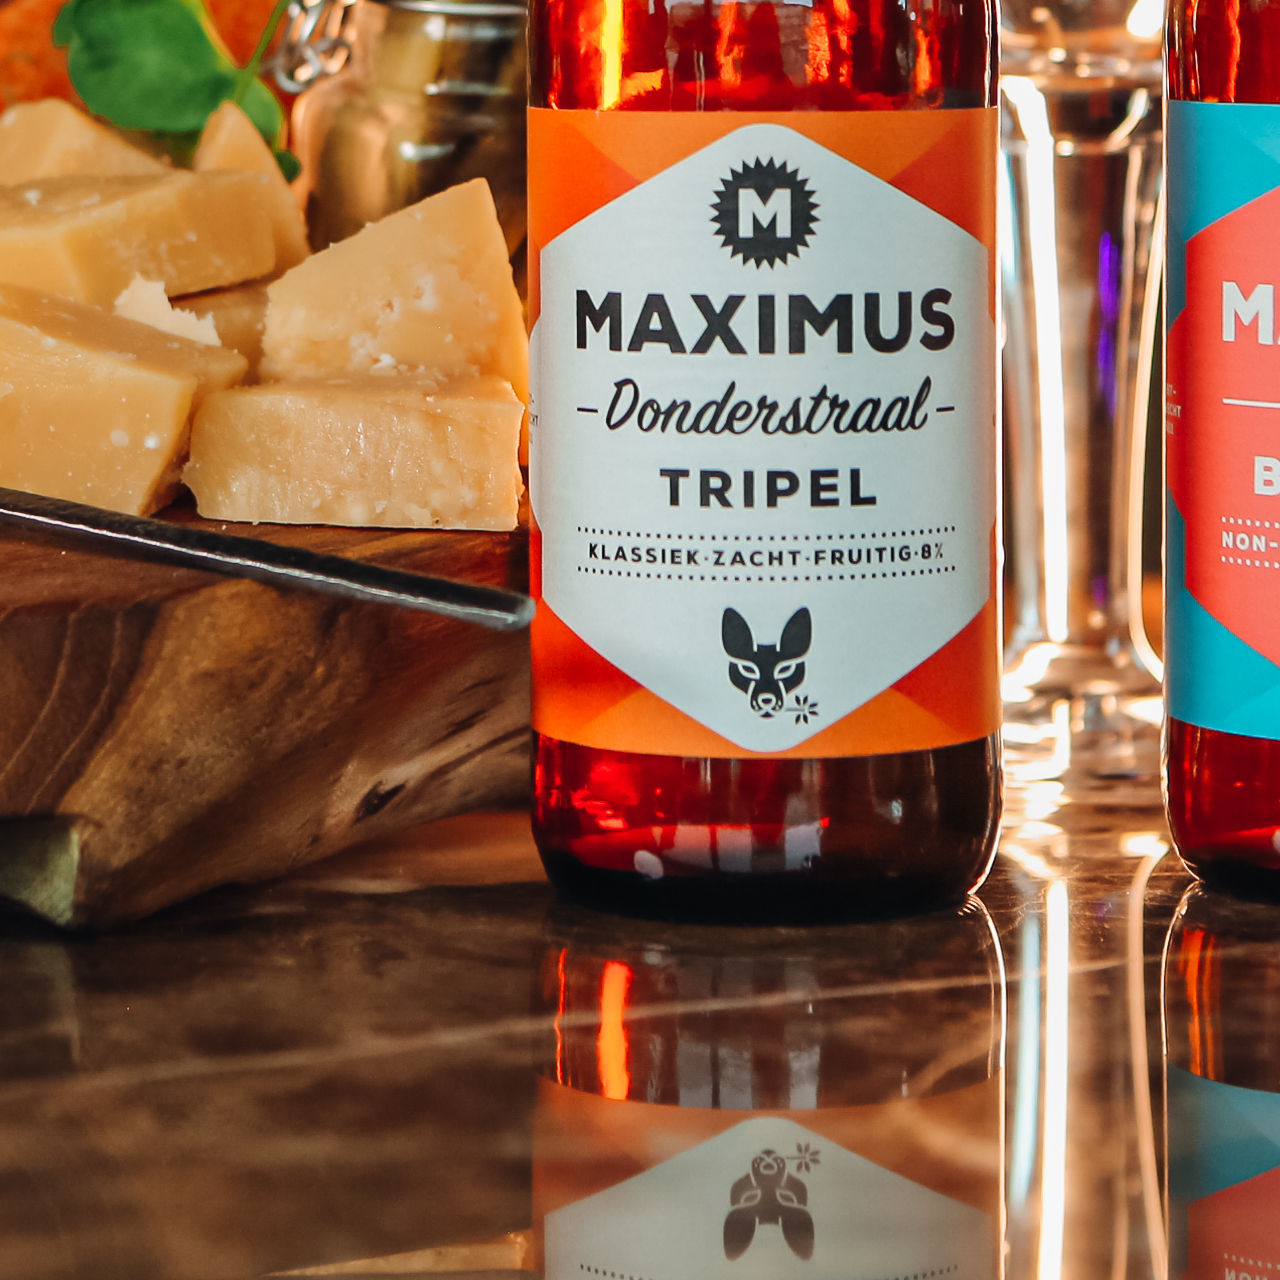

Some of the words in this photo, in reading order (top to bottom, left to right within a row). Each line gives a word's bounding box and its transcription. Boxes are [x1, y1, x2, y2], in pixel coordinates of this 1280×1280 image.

[738, 188, 792, 239] M
[575, 287, 956, 355] MAXIMUS
[605, 375, 933, 436] Donderstraal
[659, 468, 877, 508] TRIPEL
